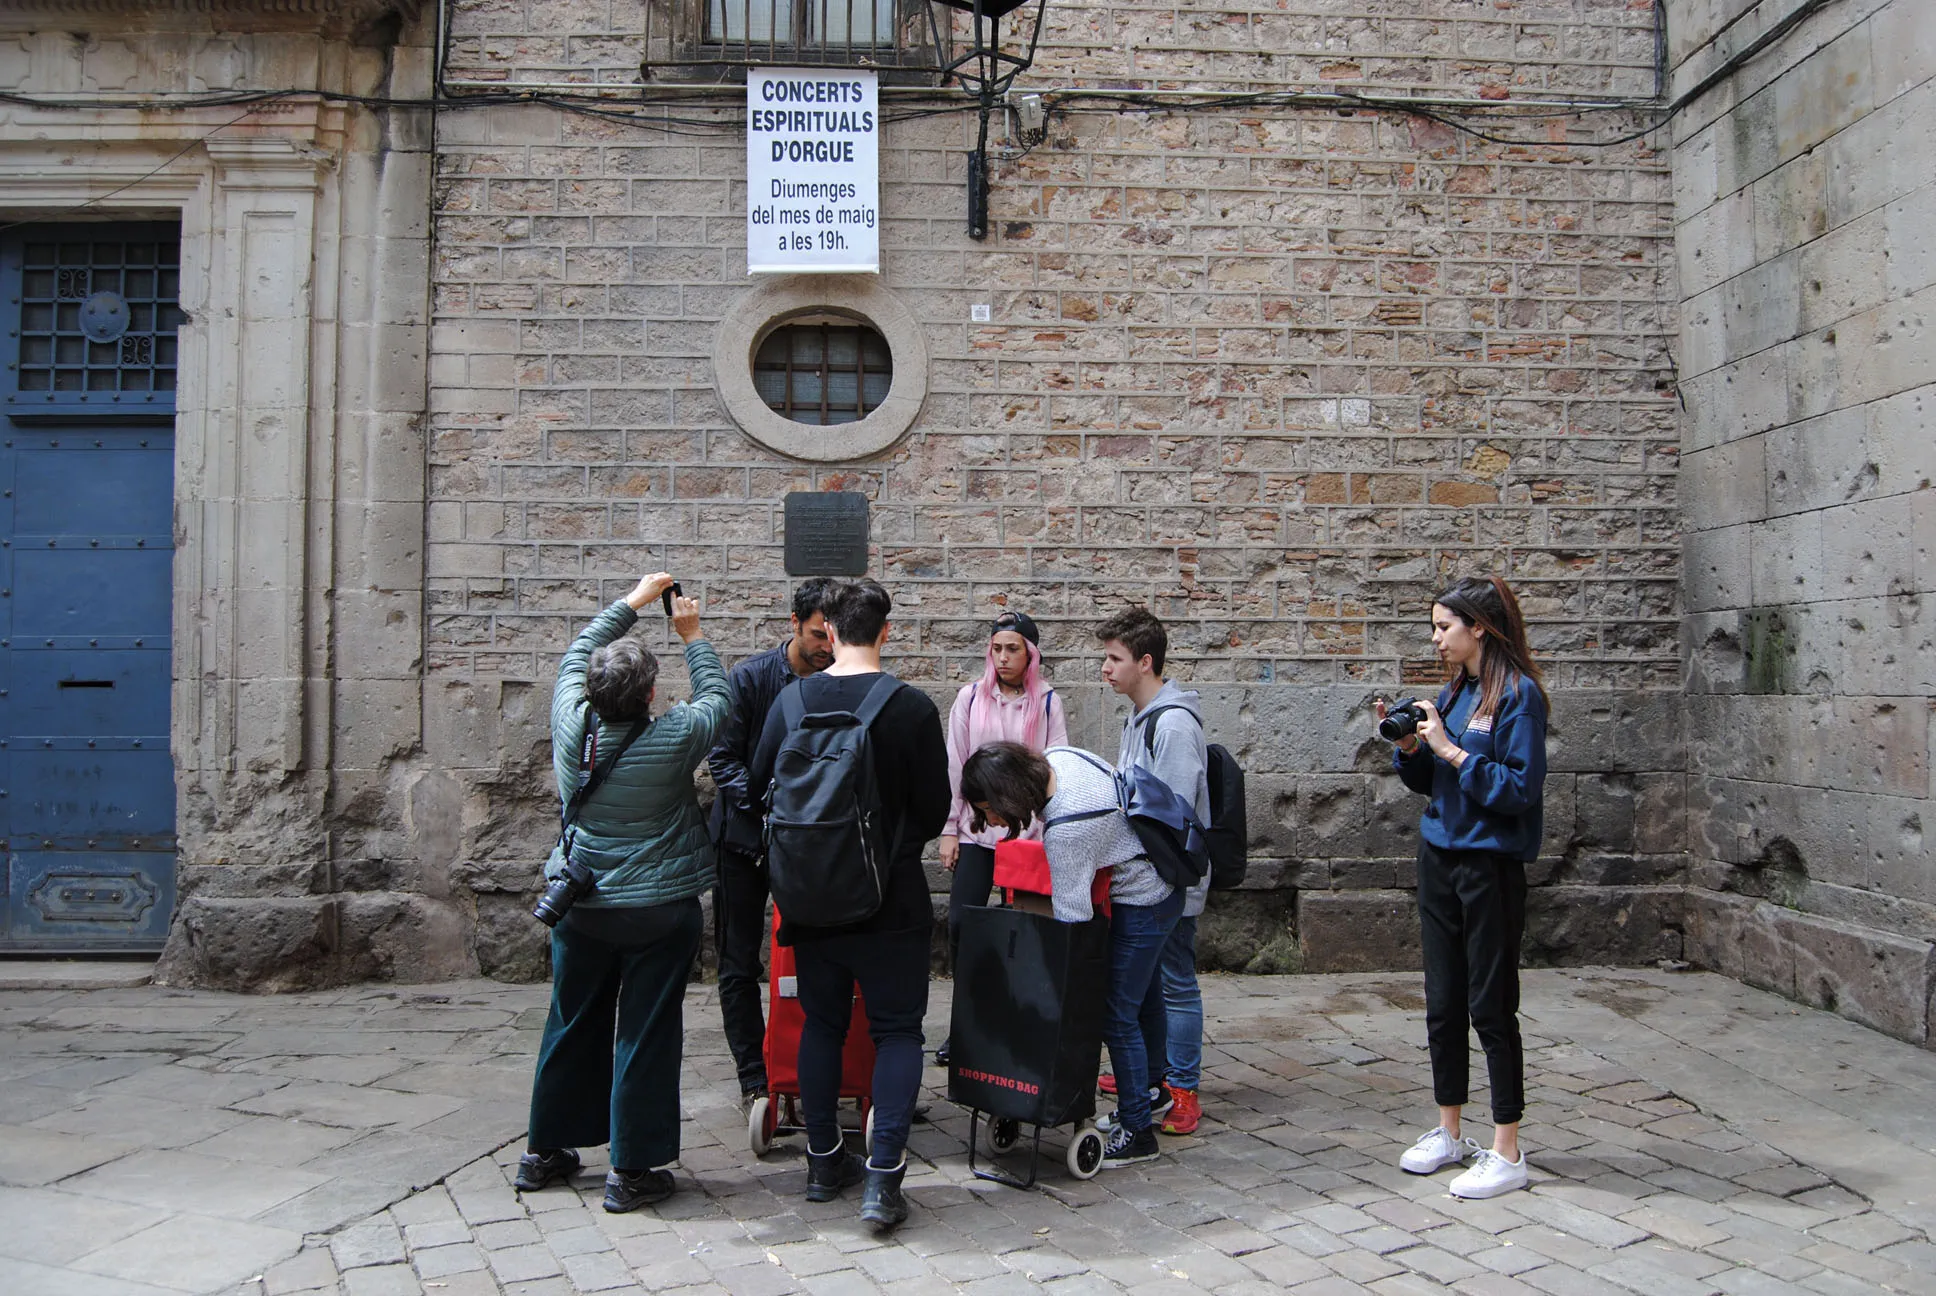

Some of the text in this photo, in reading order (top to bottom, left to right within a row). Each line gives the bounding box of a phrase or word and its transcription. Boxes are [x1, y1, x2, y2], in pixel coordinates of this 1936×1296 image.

[762, 80, 863, 103] CONCERTS
[752, 110, 873, 133] ESPIRITUALS
[771, 140, 854, 163] D'ORGUE
[771, 178, 856, 203] Diumenges
[752, 205, 875, 228] del mes de maig
[778, 230, 849, 250] a les 19h.
[583, 733, 594, 763] Canon
[958, 1067, 1039, 1095] SHOPPING BAG
